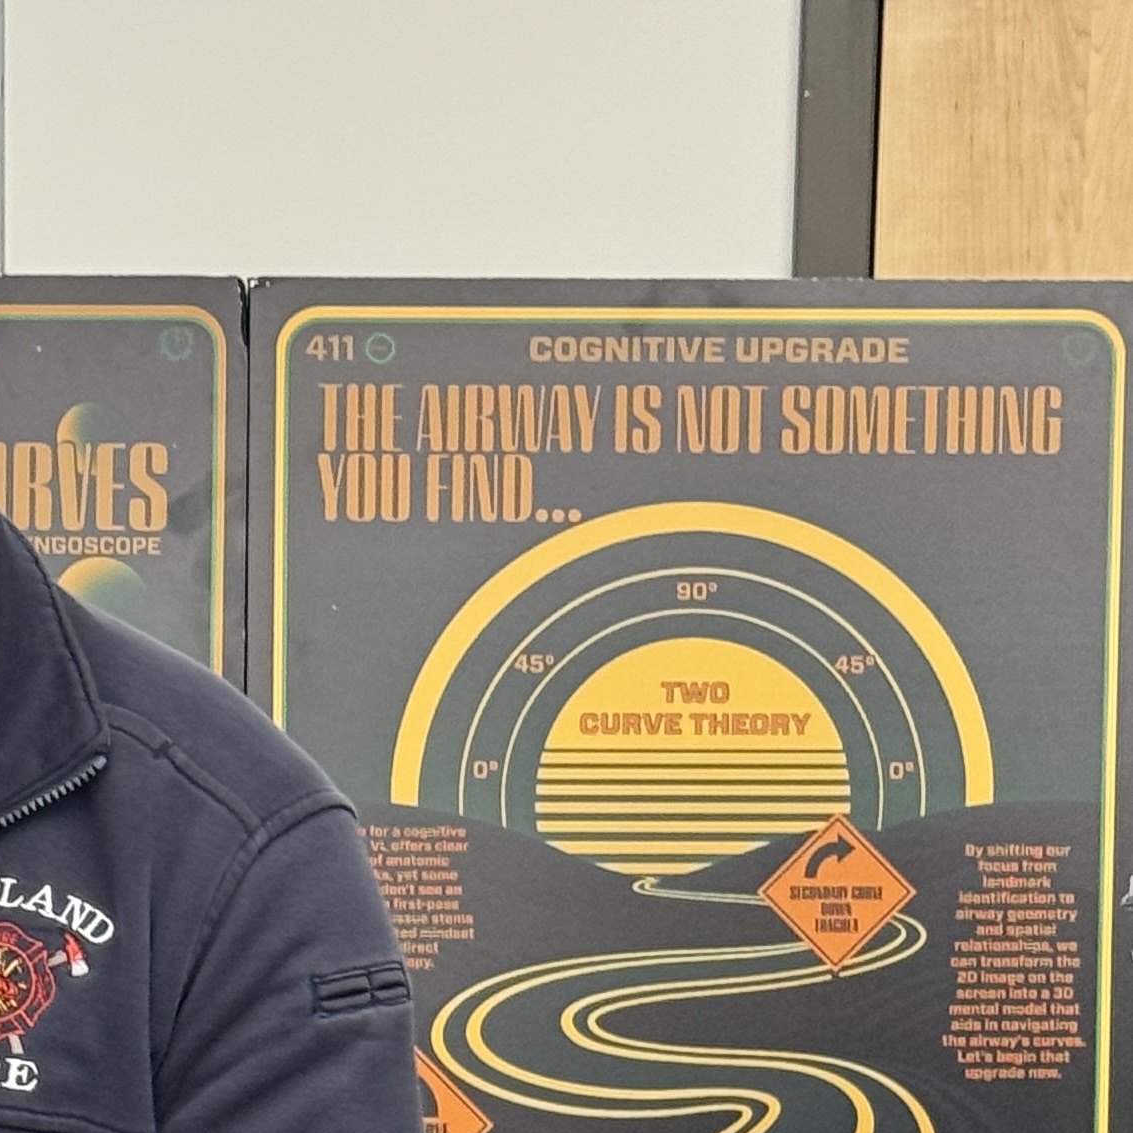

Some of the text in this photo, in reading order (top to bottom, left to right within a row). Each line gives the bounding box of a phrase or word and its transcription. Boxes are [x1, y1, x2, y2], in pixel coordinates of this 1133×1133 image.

[305, 334, 354, 361] 411
[528, 336, 910, 364] COGNITIVE UPGRADE
[318, 383, 1063, 456] THE AIRWAY IS NOT SOMETHING
[317, 453, 583, 523] YOU FIND...
[28, 536, 162, 555] NGOSCOPE
[660, 681, 730, 704] TWO
[579, 712, 811, 736] CURVE THEORY
[403, 825, 467, 840] cognitive
[390, 841, 432, 852] offers
[434, 840, 469, 852] clear
[986, 844, 1043, 859] shifting
[1045, 845, 1071, 857] our
[385, 854, 450, 867] anatomic
[978, 860, 1057, 873] focus from
[421, 870, 458, 881] some
[983, 875, 1051, 888] landmark
[418, 885, 443, 896] see
[444, 885, 463, 896] an
[958, 891, 1075, 905] identification to
[955, 907, 1078, 923] airway geometry
[976, 924, 1057, 938] and spatial
[1056, 941, 1078, 952] we
[950, 955, 1081, 968] can transform the
[980, 971, 1025, 986] image
[1027, 973, 1047, 984] on
[1049, 971, 1074, 984] the
[956, 987, 1075, 1000] screen into a 3D
[948, 1002, 1081, 1016] mental model that
[951, 1018, 1079, 1034] aids in navigating
[941, 1034, 967, 1047] the
[969, 1033, 1031, 1050] airway's
[957, 1049, 1071, 1065] Let's begin that
[965, 1066, 1026, 1082] upgrade
